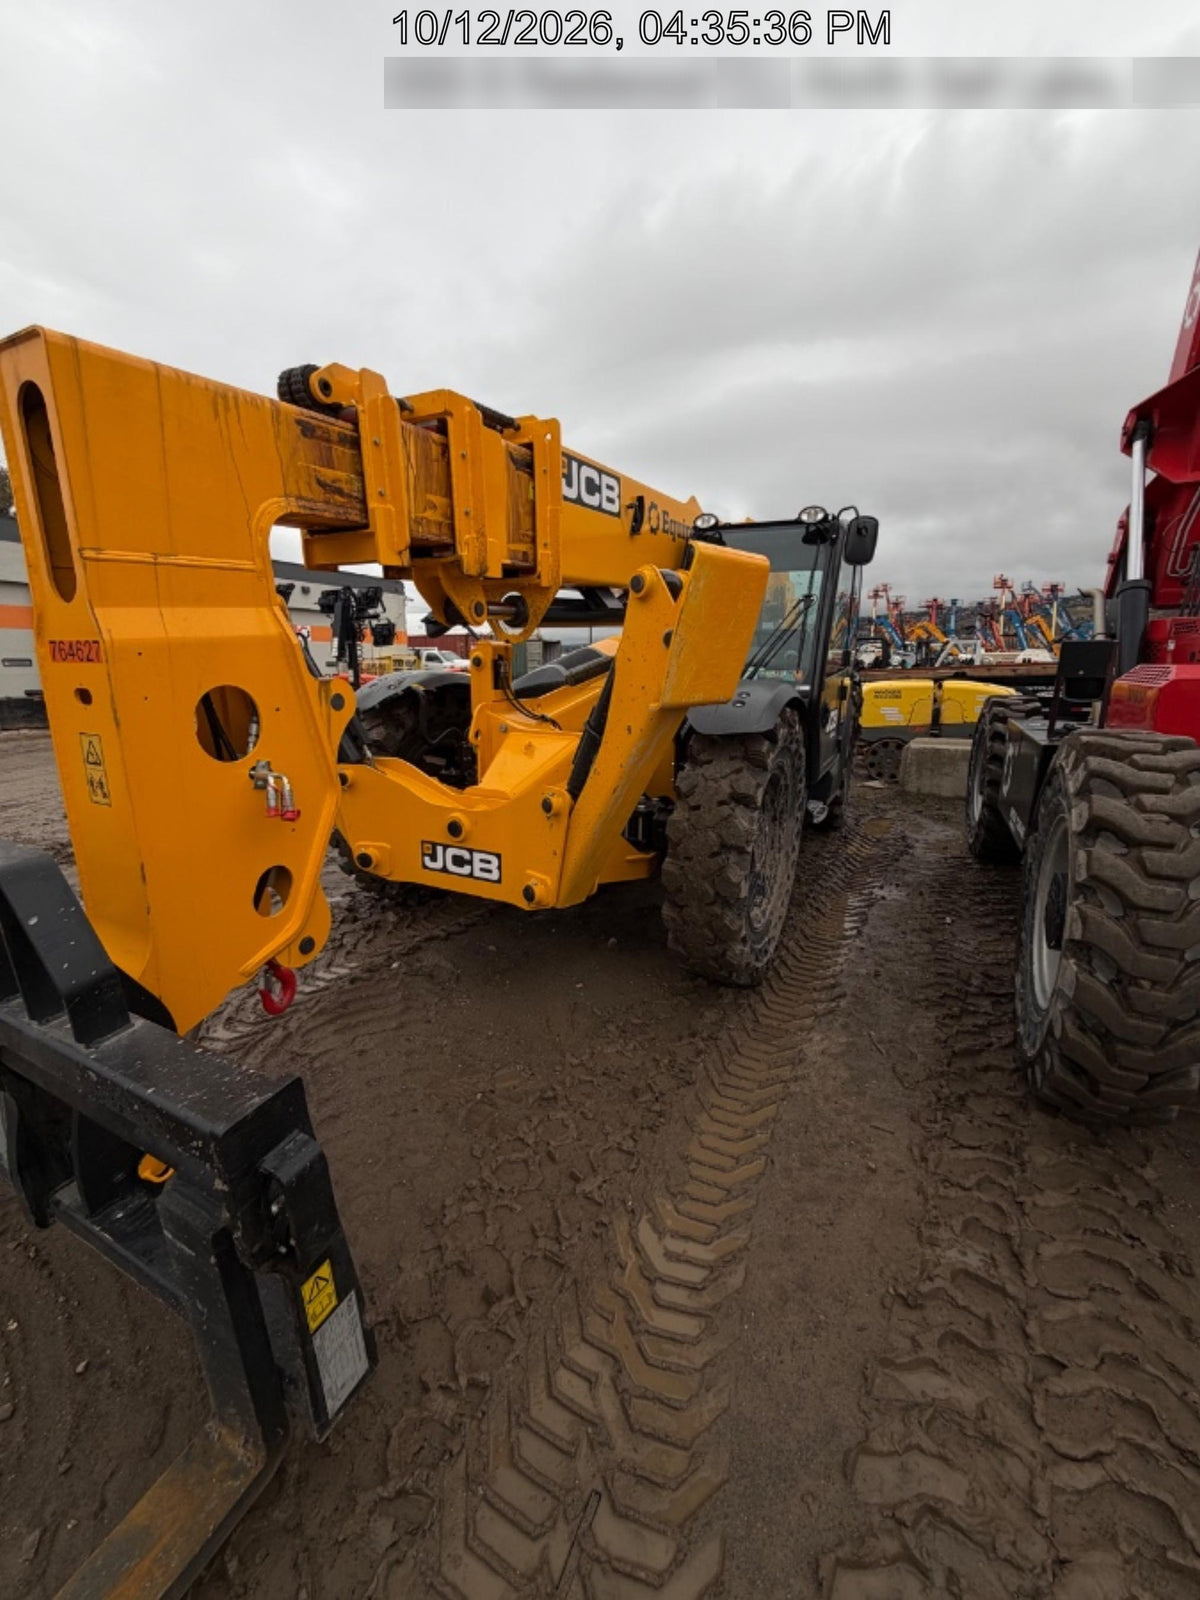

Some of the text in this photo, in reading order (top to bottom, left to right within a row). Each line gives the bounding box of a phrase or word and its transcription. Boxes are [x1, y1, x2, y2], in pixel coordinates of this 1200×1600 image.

[562, 459, 620, 514] JCB
[49, 640, 101, 662] 764627
[423, 845, 500, 881] JCB
